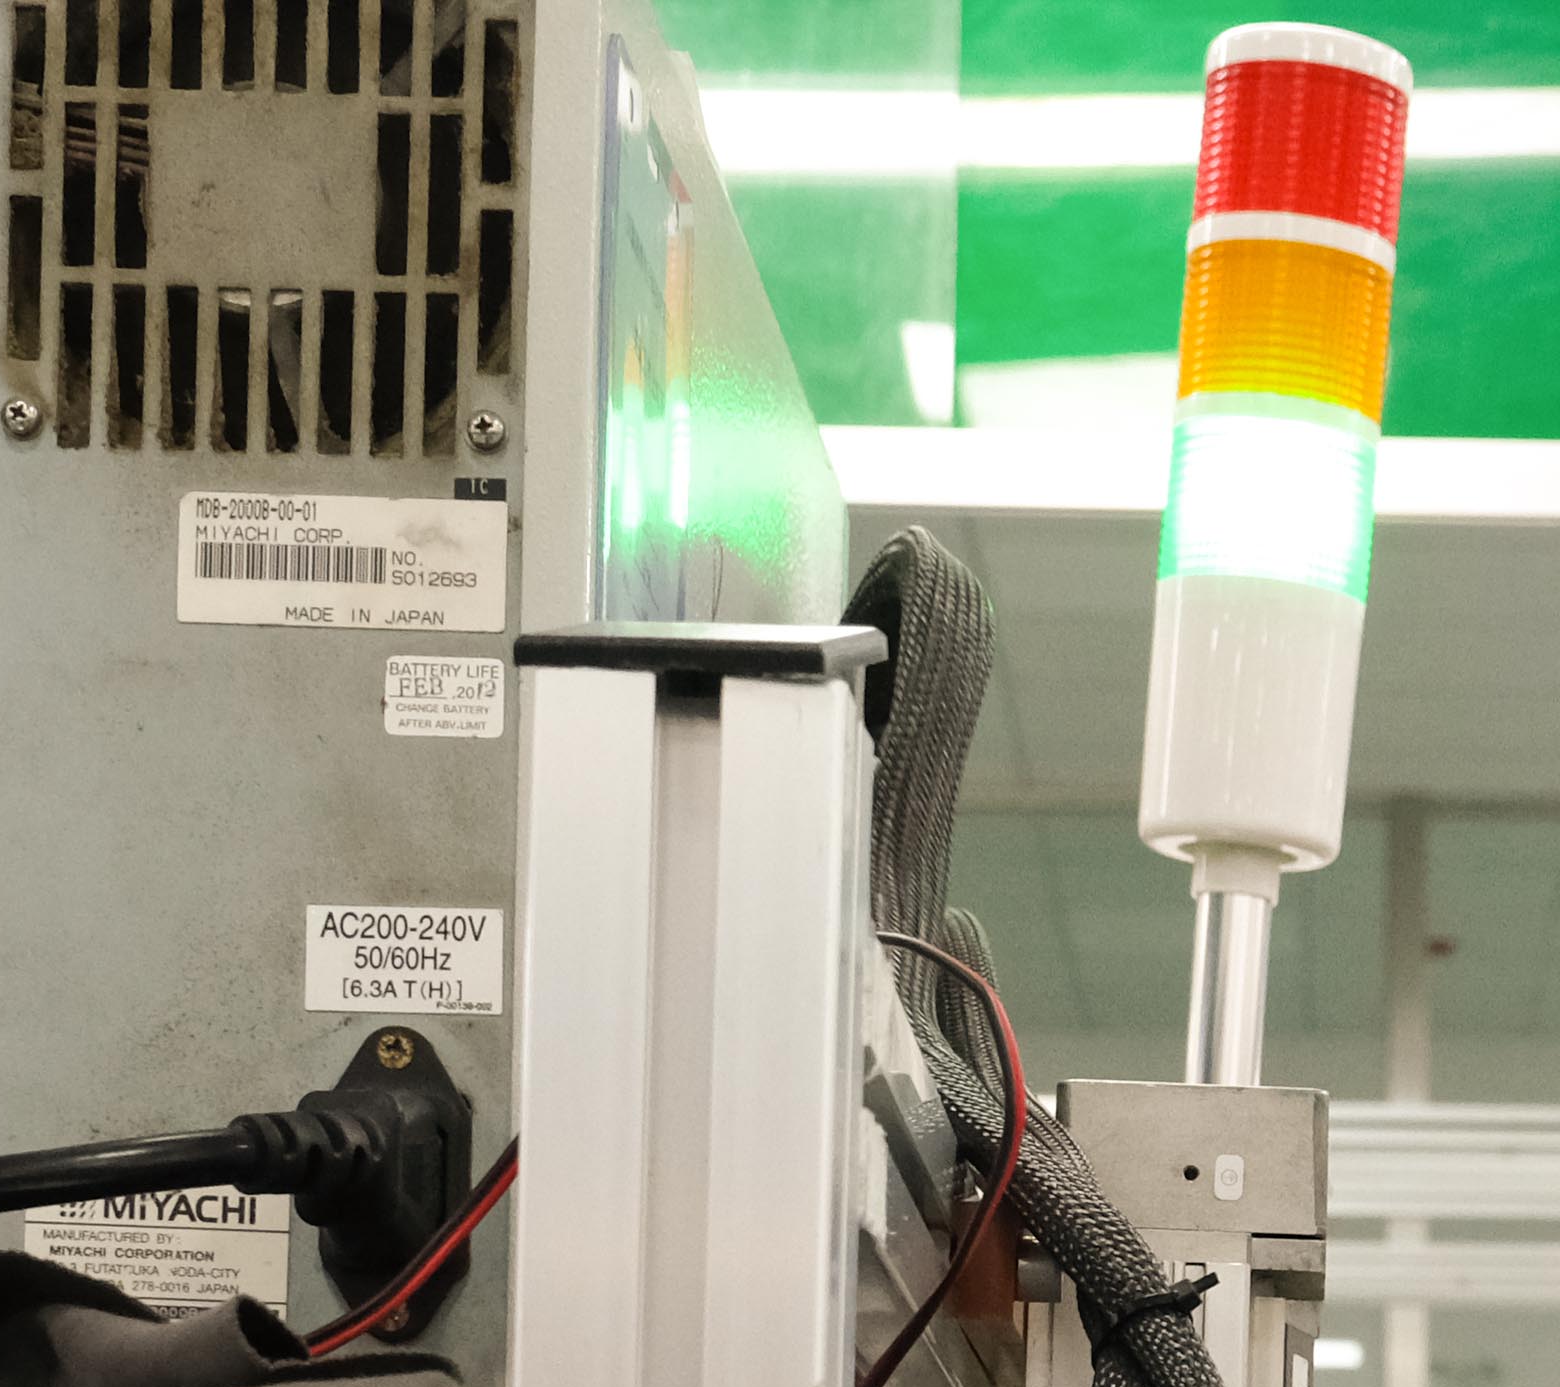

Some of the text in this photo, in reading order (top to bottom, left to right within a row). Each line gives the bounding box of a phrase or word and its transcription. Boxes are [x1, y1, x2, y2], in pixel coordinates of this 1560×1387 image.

[196, 525, 350, 545] MIYACHI CORP.
[391, 551, 424, 567] NO.
[285, 606, 445, 626] MADE IN JAPAN
[389, 662, 500, 679] BATTERY LIFE
[399, 677, 444, 697] FEB
[395, 703, 489, 715] CHANGE BATTERY
[398, 719, 432, 729] AFTER
[320, 911, 486, 942] AC200-240V
[354, 946, 452, 971] 50/60Hz
[43, 1229, 150, 1244] MANUFACTURED
[50, 1246, 215, 1262] MIYACHI CORPORATION
[197, 1283, 239, 1295] JAPAN
